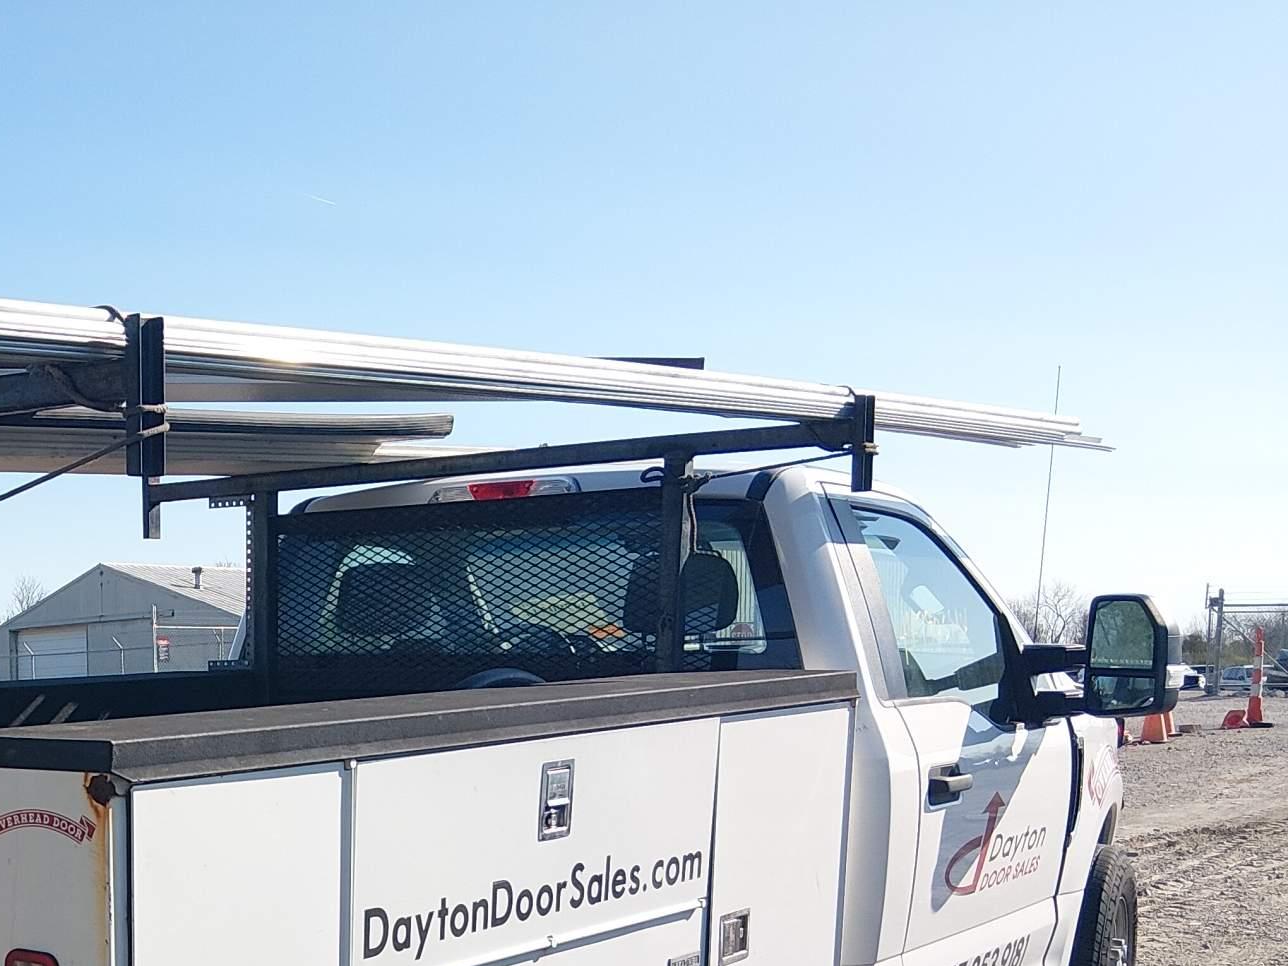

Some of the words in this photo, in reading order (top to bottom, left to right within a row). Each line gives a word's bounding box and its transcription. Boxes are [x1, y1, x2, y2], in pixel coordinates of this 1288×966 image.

[52, 814, 83, 840] DOOR
[989, 825, 1047, 862] Dayton
[979, 864, 1012, 892] DOOR
[1012, 856, 1041, 880] SALES
[362, 850, 703, 961] DaytonDoorSales.com
